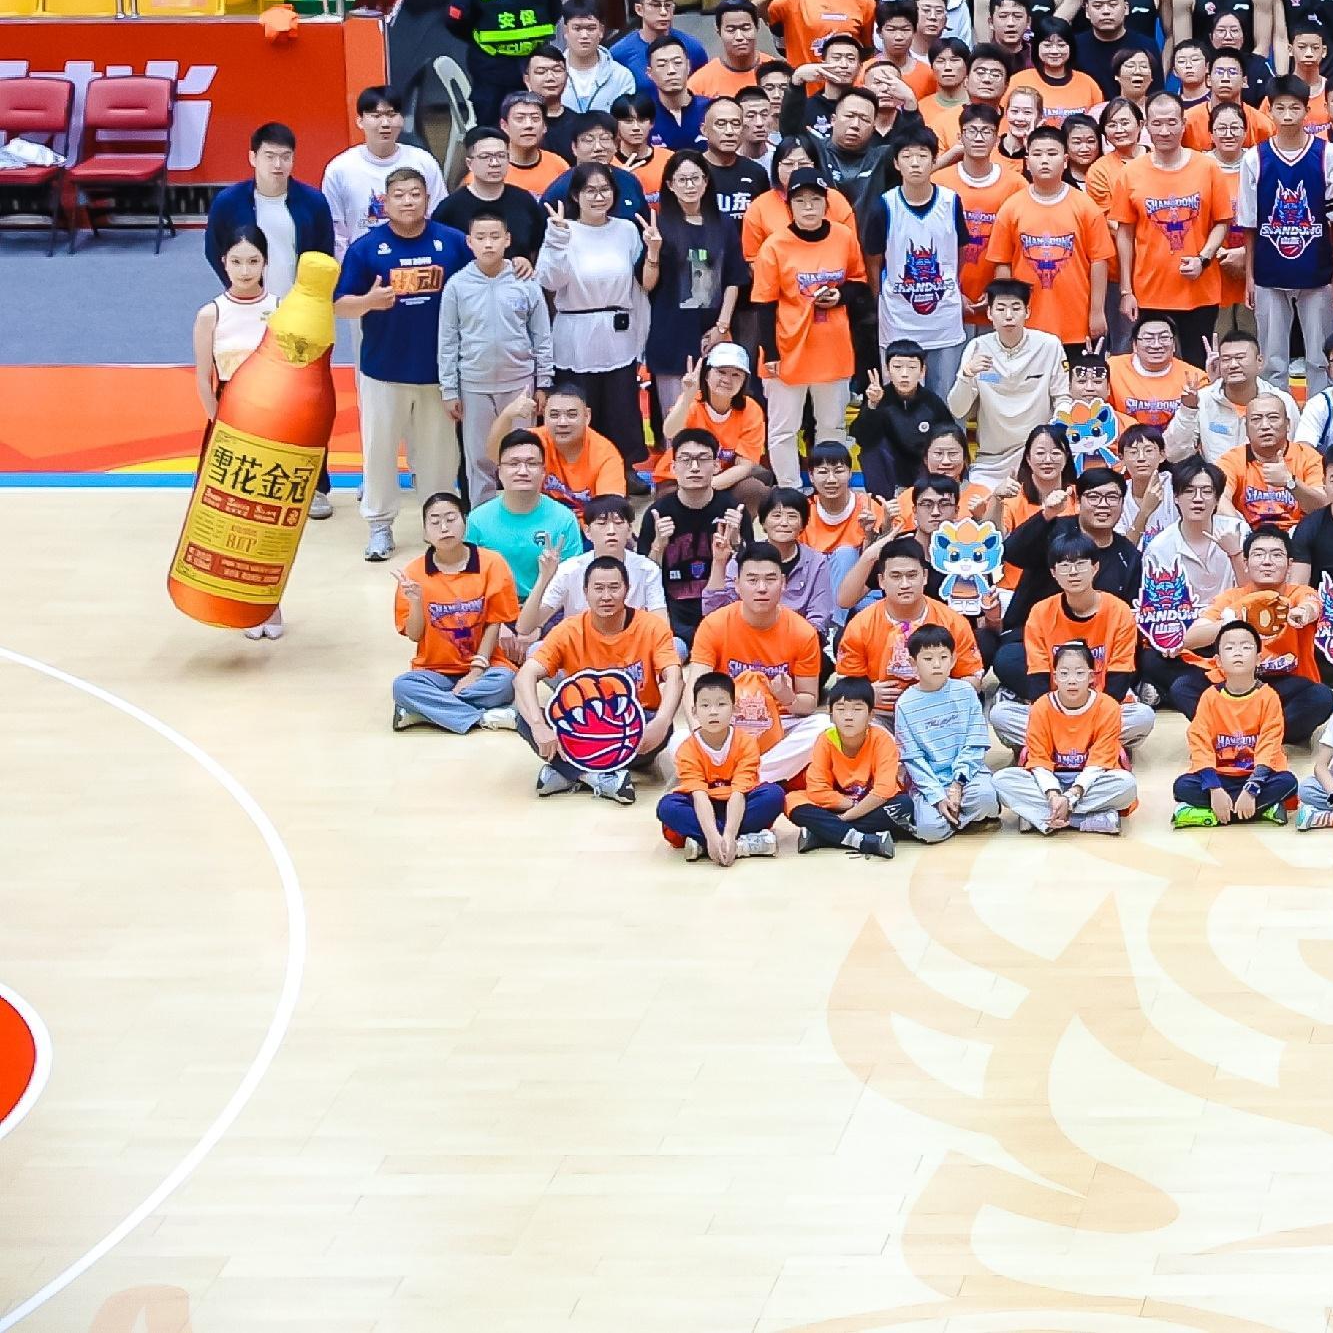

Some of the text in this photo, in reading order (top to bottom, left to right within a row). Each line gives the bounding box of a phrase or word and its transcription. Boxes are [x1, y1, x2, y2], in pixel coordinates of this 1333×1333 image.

[498, 8, 538, 29] 安保
[1145, 193, 1201, 213] SHANDONG
[207, 445, 312, 504] 雪花金冠
